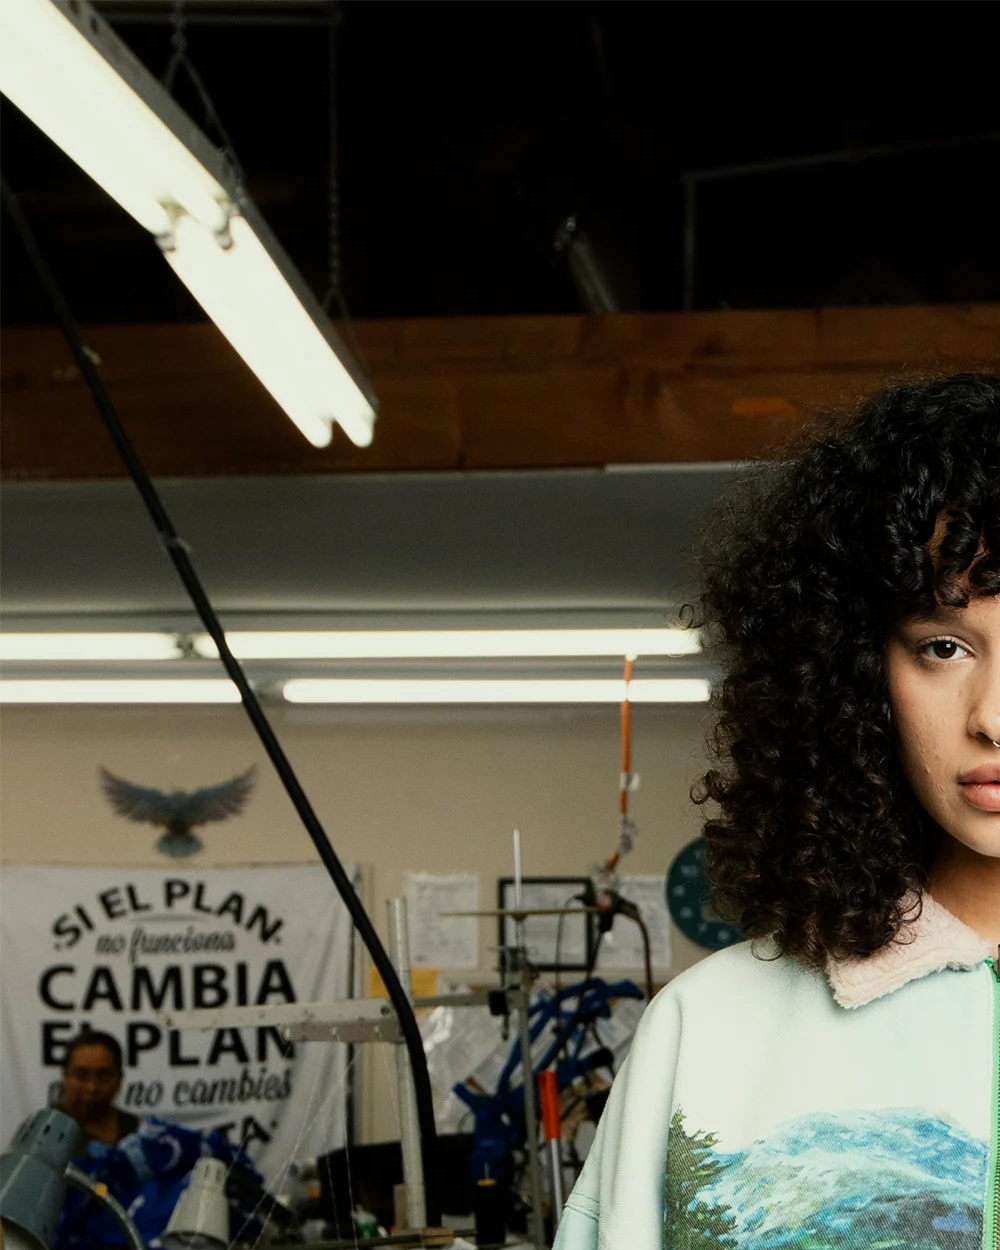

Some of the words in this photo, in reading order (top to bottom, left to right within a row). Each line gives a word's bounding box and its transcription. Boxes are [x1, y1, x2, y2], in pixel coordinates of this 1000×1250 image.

[52, 903, 95, 950] SI
[97, 882, 153, 921] EL
[95, 933, 127, 955] no
[38, 959, 297, 1013] CAMBIA
[125, 1020, 296, 1069] PLAN
[124, 1079, 164, 1107] no
[172, 1066, 293, 1106] cambies
